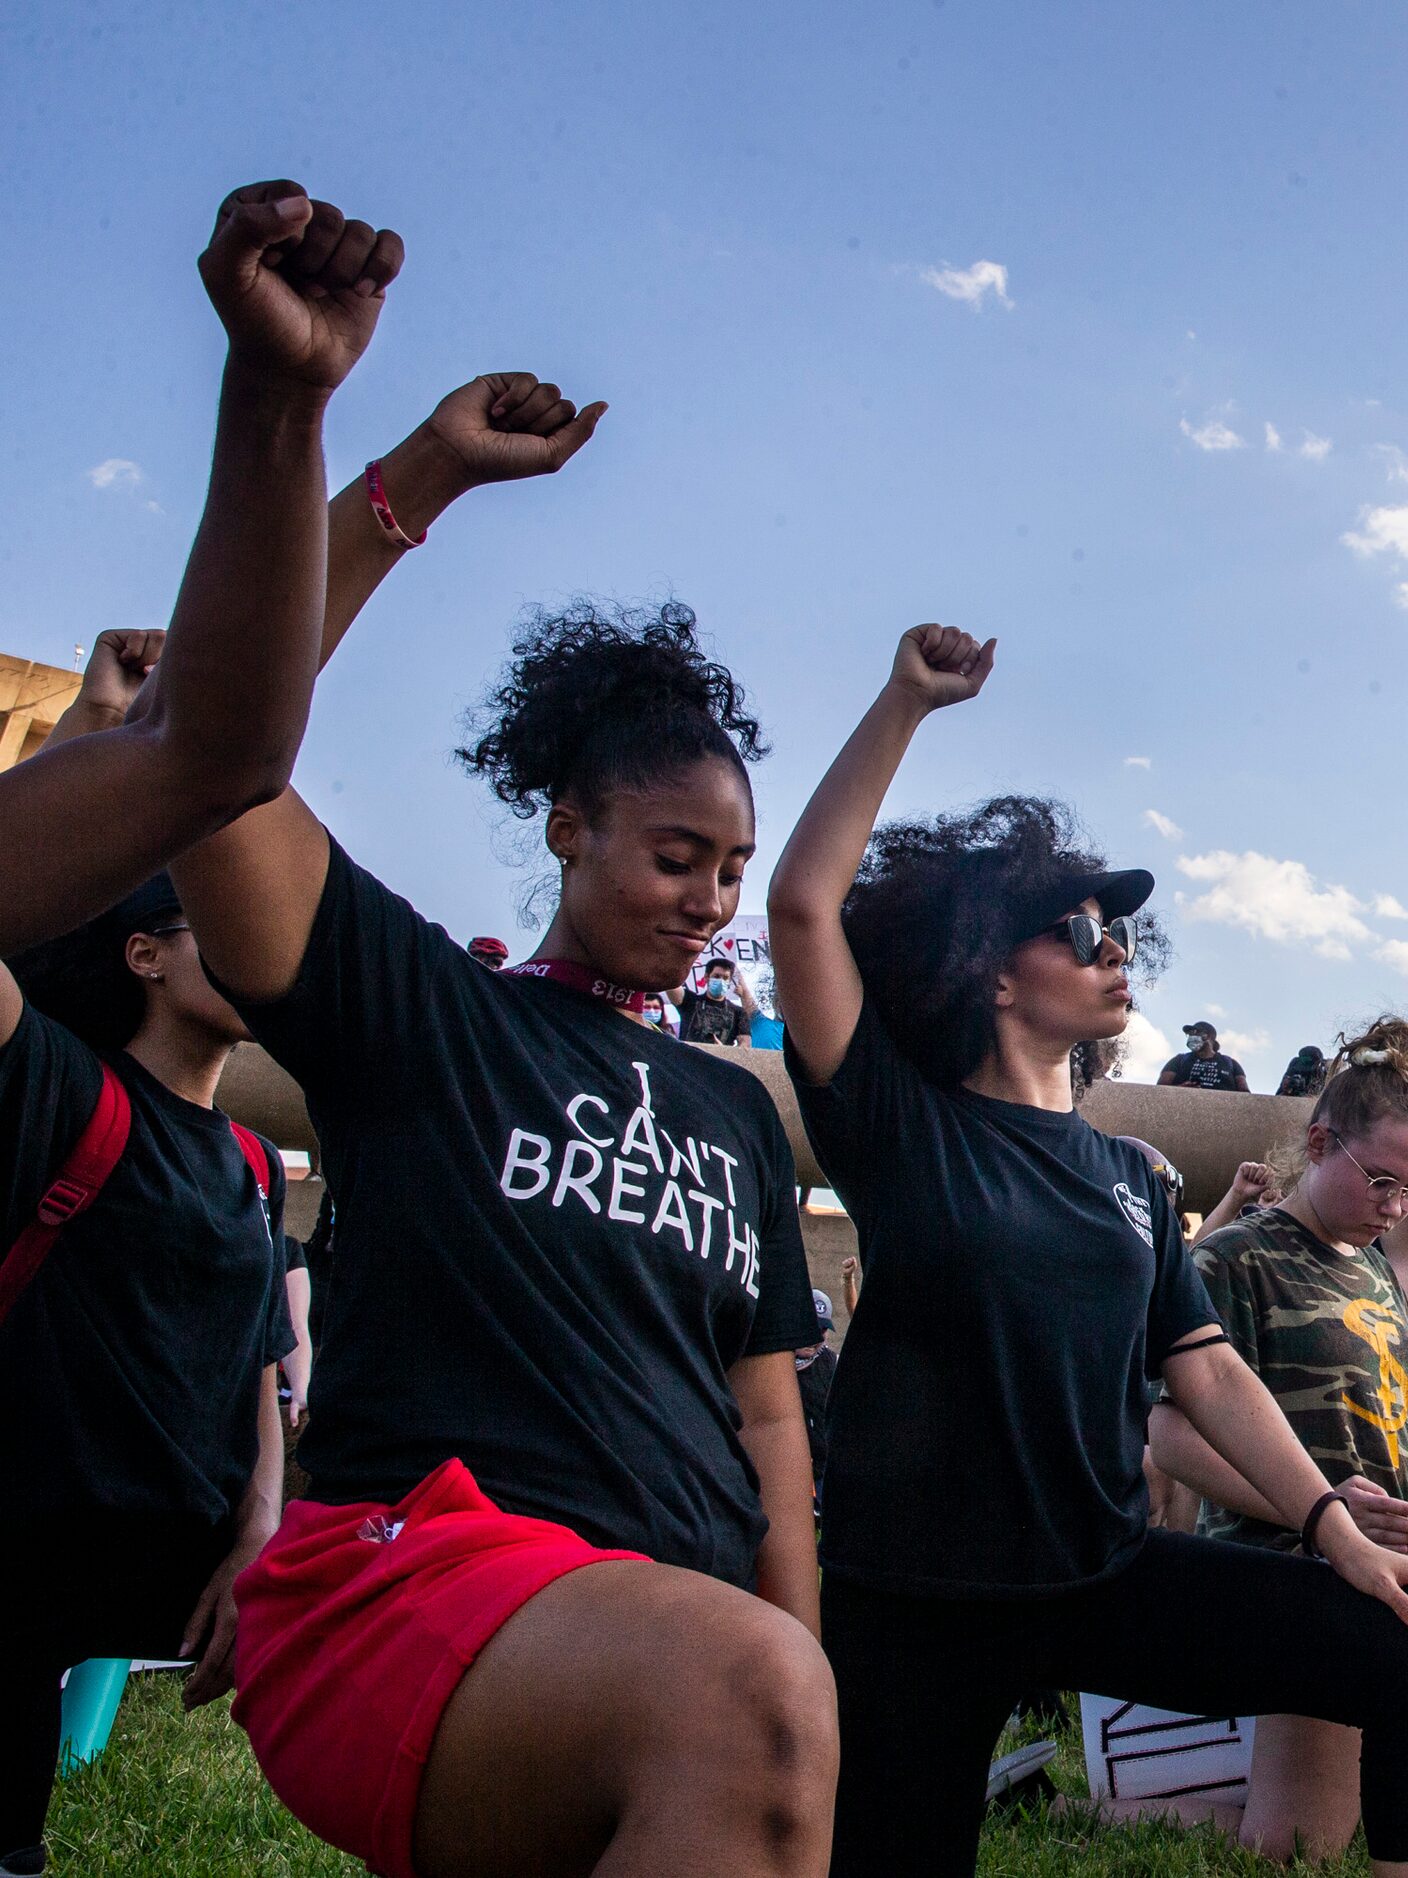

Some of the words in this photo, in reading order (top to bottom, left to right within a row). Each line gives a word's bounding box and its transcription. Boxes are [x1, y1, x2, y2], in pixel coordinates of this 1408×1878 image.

[592, 979, 636, 1005] 1913
[632, 1061, 655, 1118] I
[566, 1093, 738, 1207] CAN'T
[500, 1127, 760, 1299] BREATHE
